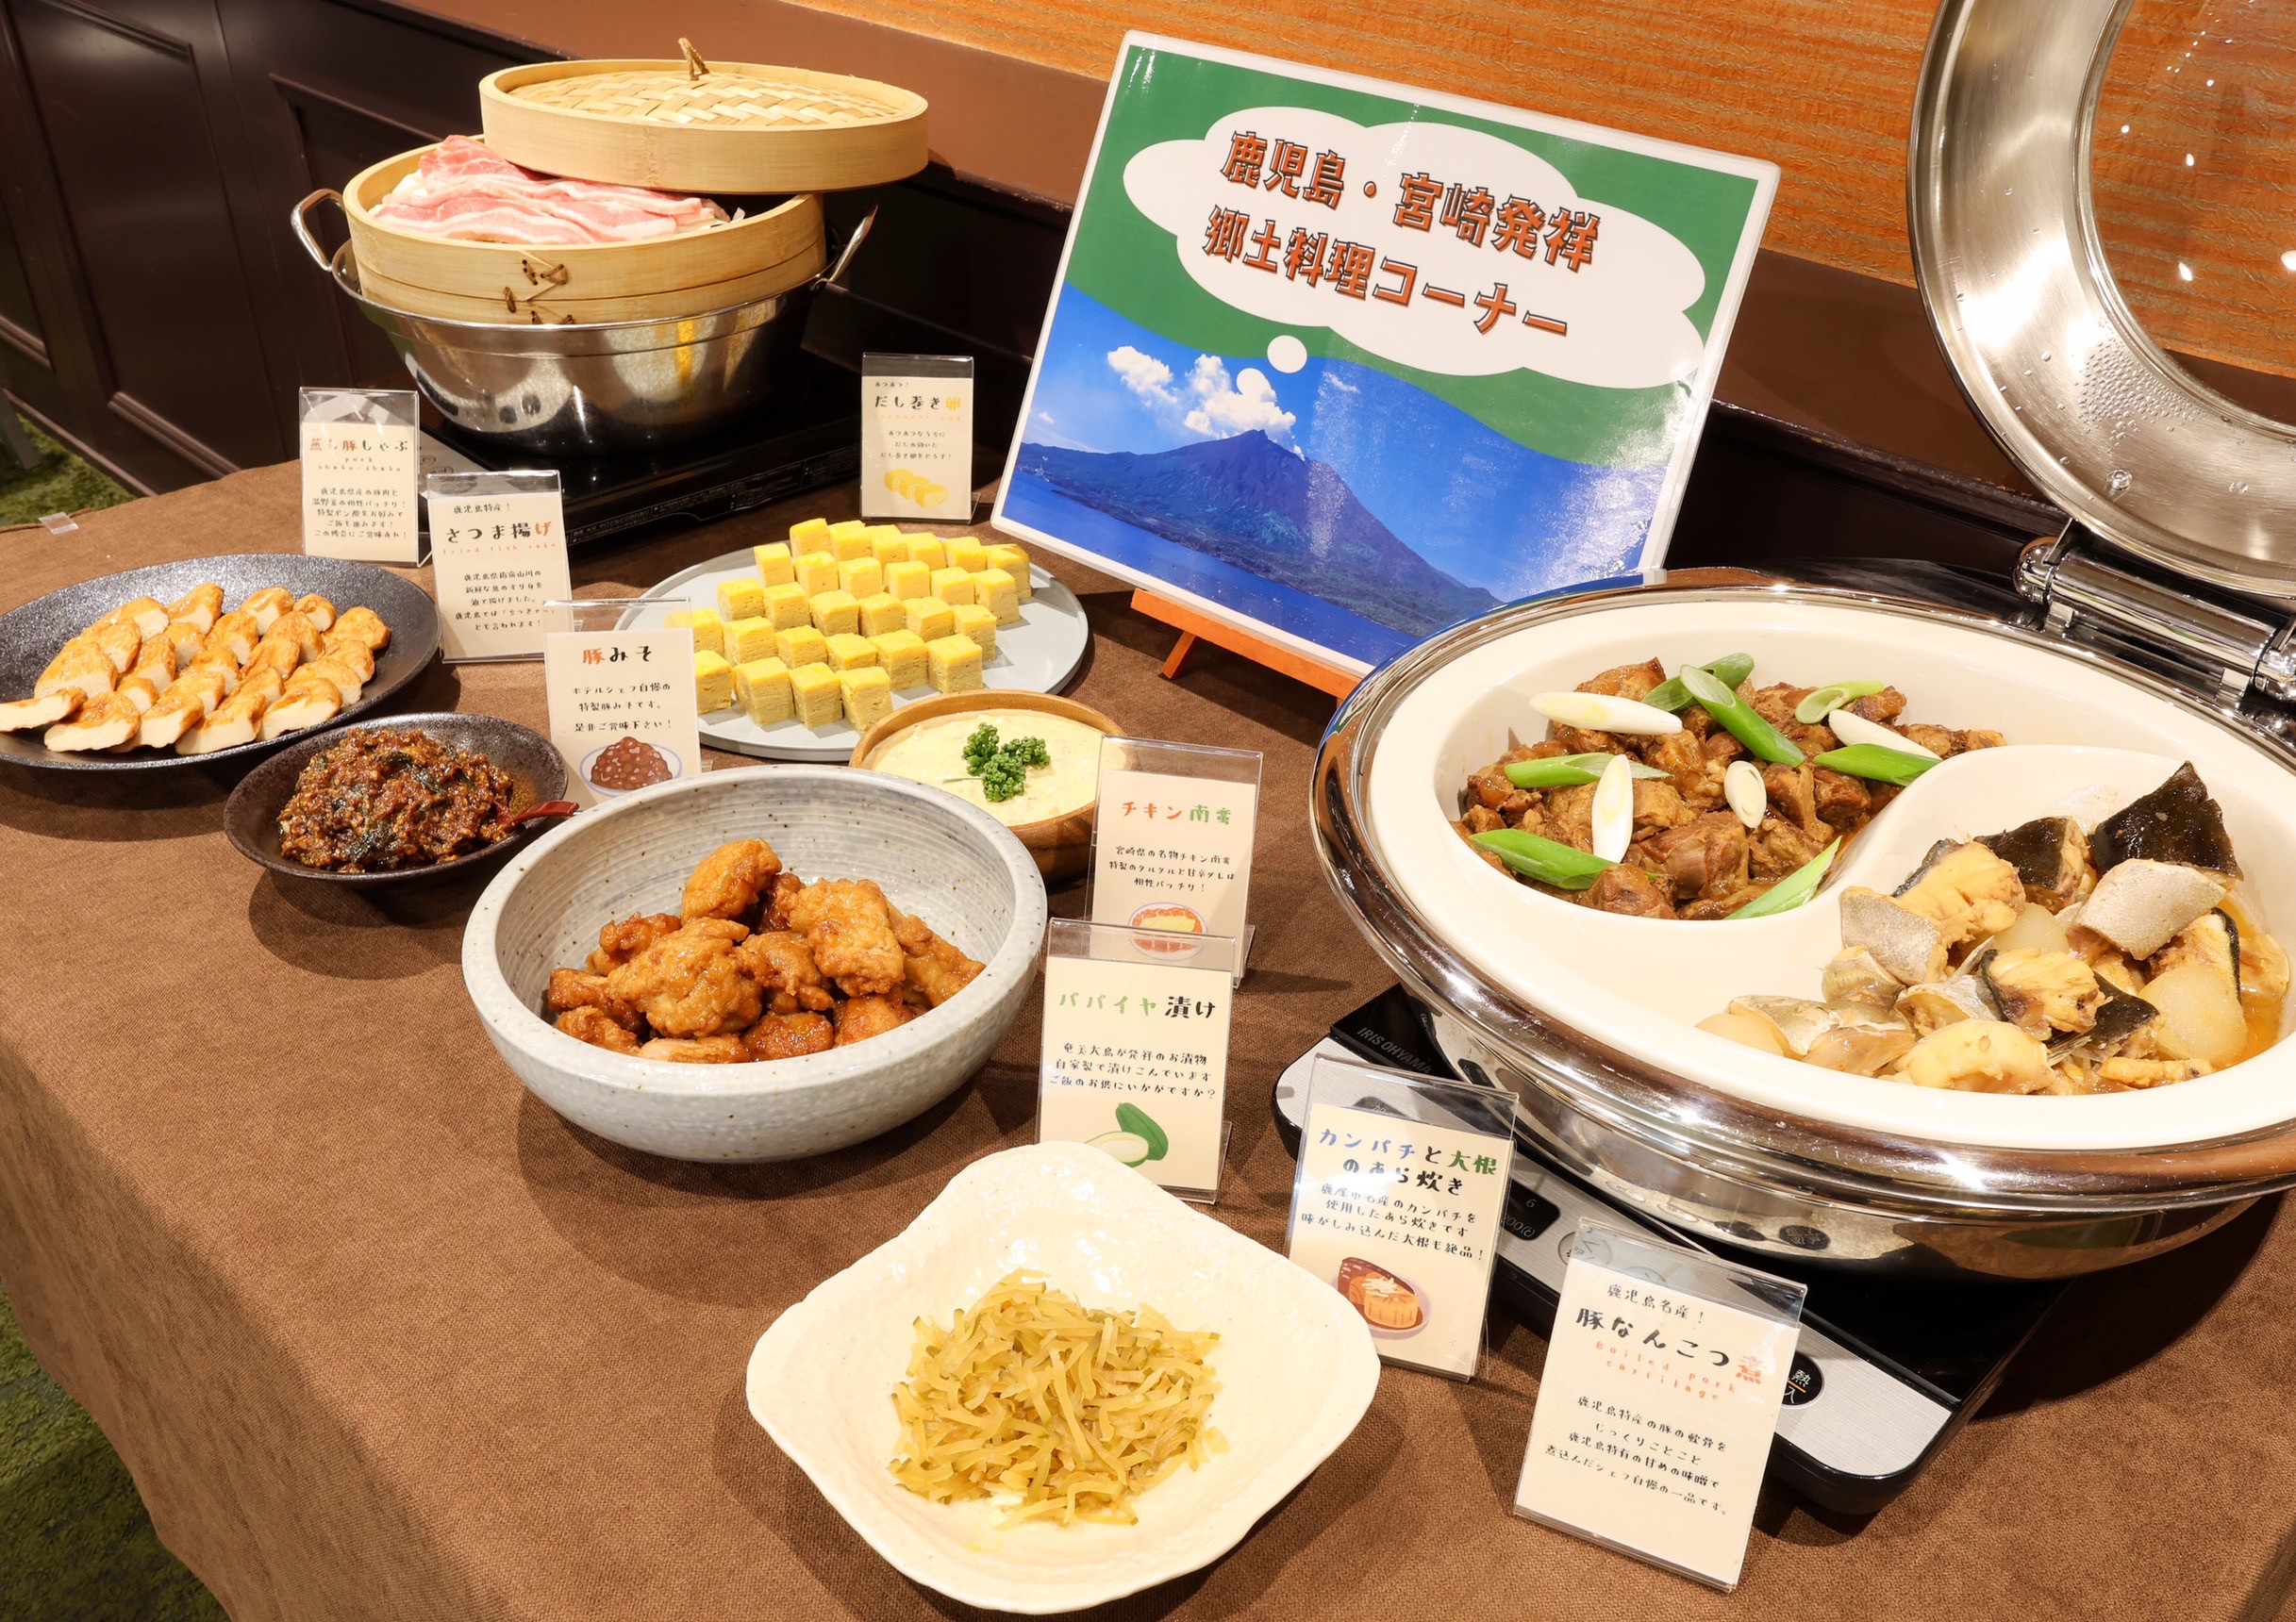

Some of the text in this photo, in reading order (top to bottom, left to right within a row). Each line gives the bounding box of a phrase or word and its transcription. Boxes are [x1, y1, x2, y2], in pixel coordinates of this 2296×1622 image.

[1220, 130, 1601, 273] 鹿児島・宮崎発祥
[1202, 204, 1569, 338] 郷土料理コーナー
[446, 521, 553, 544] さつま揚げ
[582, 645, 653, 666] 豚みそ
[573, 682, 671, 695] ホテルシェフ自慢の
[1122, 802, 1232, 825] チキン南蛮
[1115, 845, 1231, 865] 宮崎県の名物チキン南蛮
[1058, 991, 1217, 1019] パパイヤ漬け
[1056, 1057, 1212, 1083] 自家製で漬けこんでいます
[1063, 1041, 1207, 1067] 奄美大島が発祥のお漬物
[1356, 1026, 1386, 1048] IRIS
[1380, 1041, 1433, 1074] OHYAMA
[1319, 1127, 1498, 1176] カンパチと大根
[1324, 1198, 1470, 1238] 使用したあら炊きです
[1525, 1198, 1538, 1208] 6
[1595, 1340, 1737, 1395] Boiled pork
[1606, 1360, 1720, 1402] cartilage
[1576, 1395, 1728, 1453] 鹿児島特産の豚の軟骨を
[1595, 1422, 1703, 1466] じっくりことこと
[1568, 1431, 1721, 1490] 鹿児島特有の甘めの味噌で
